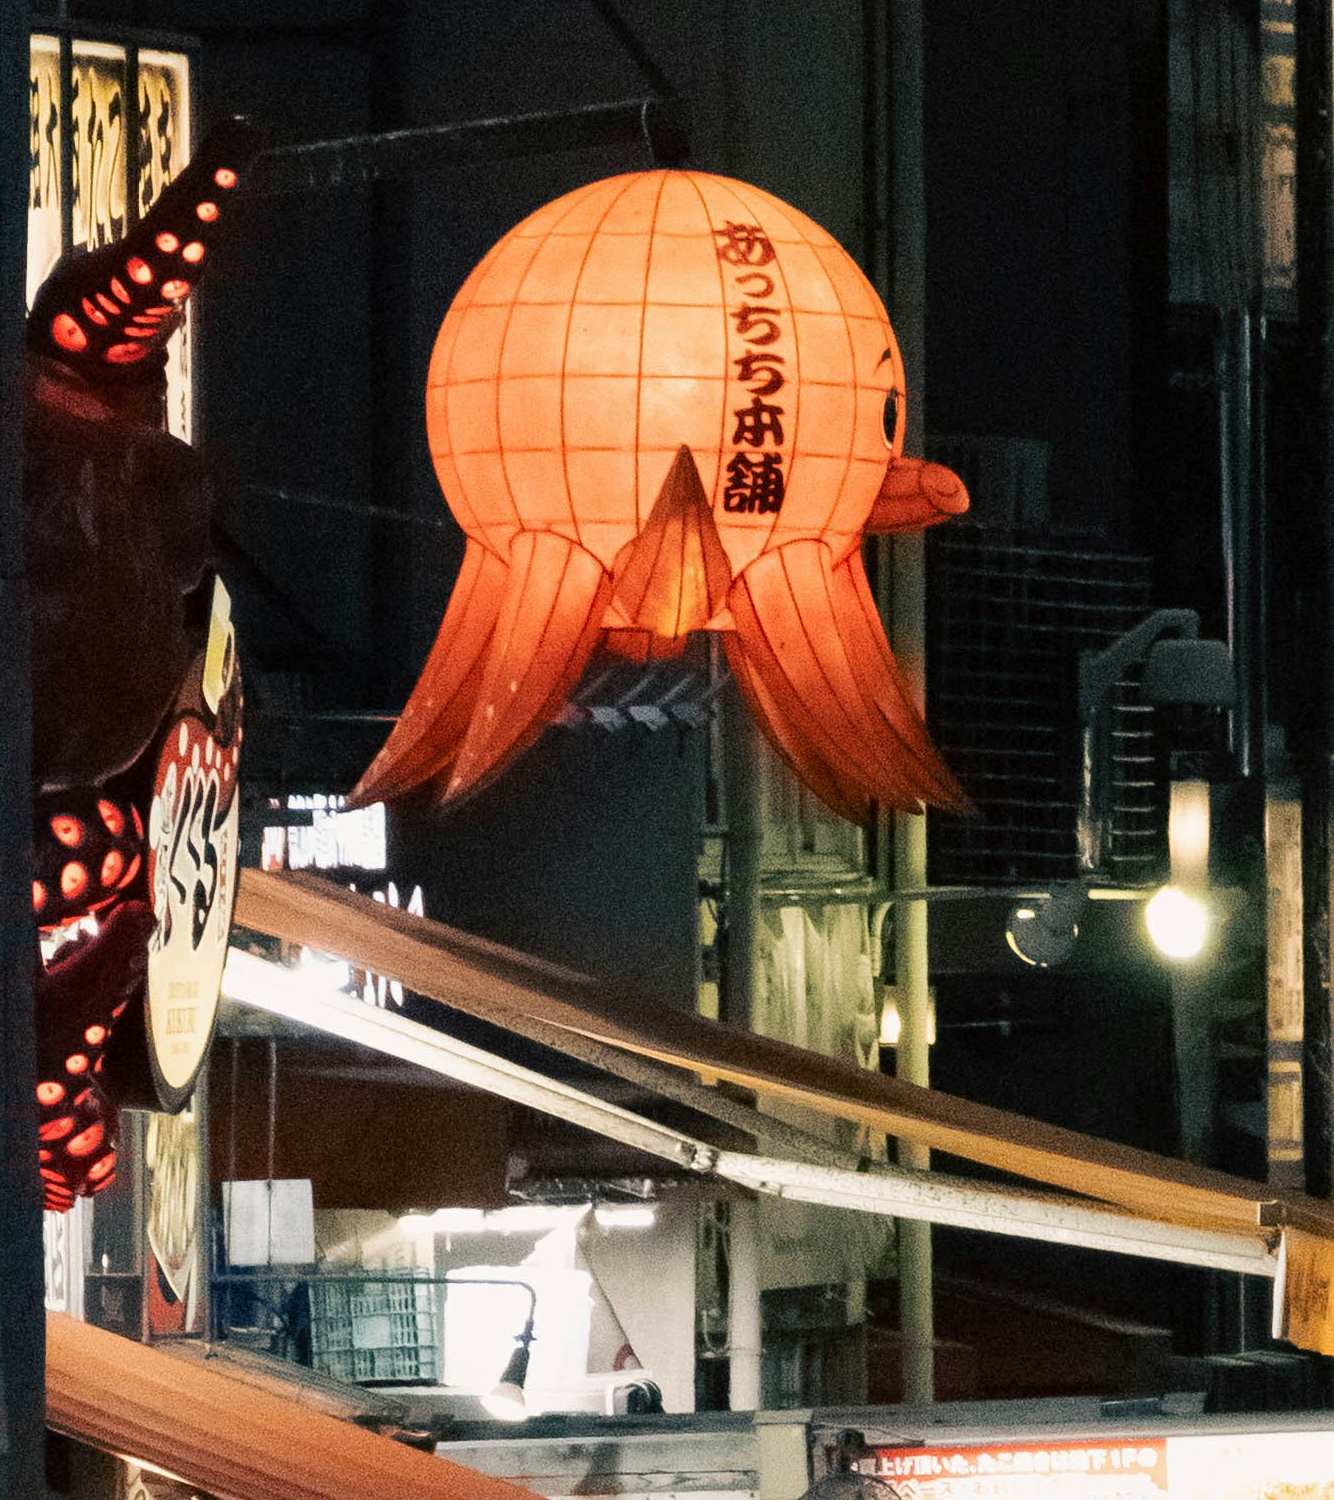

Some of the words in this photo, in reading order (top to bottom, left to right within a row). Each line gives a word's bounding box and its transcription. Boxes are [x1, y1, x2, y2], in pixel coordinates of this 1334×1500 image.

[712, 220, 786, 514] あっちち本舗
